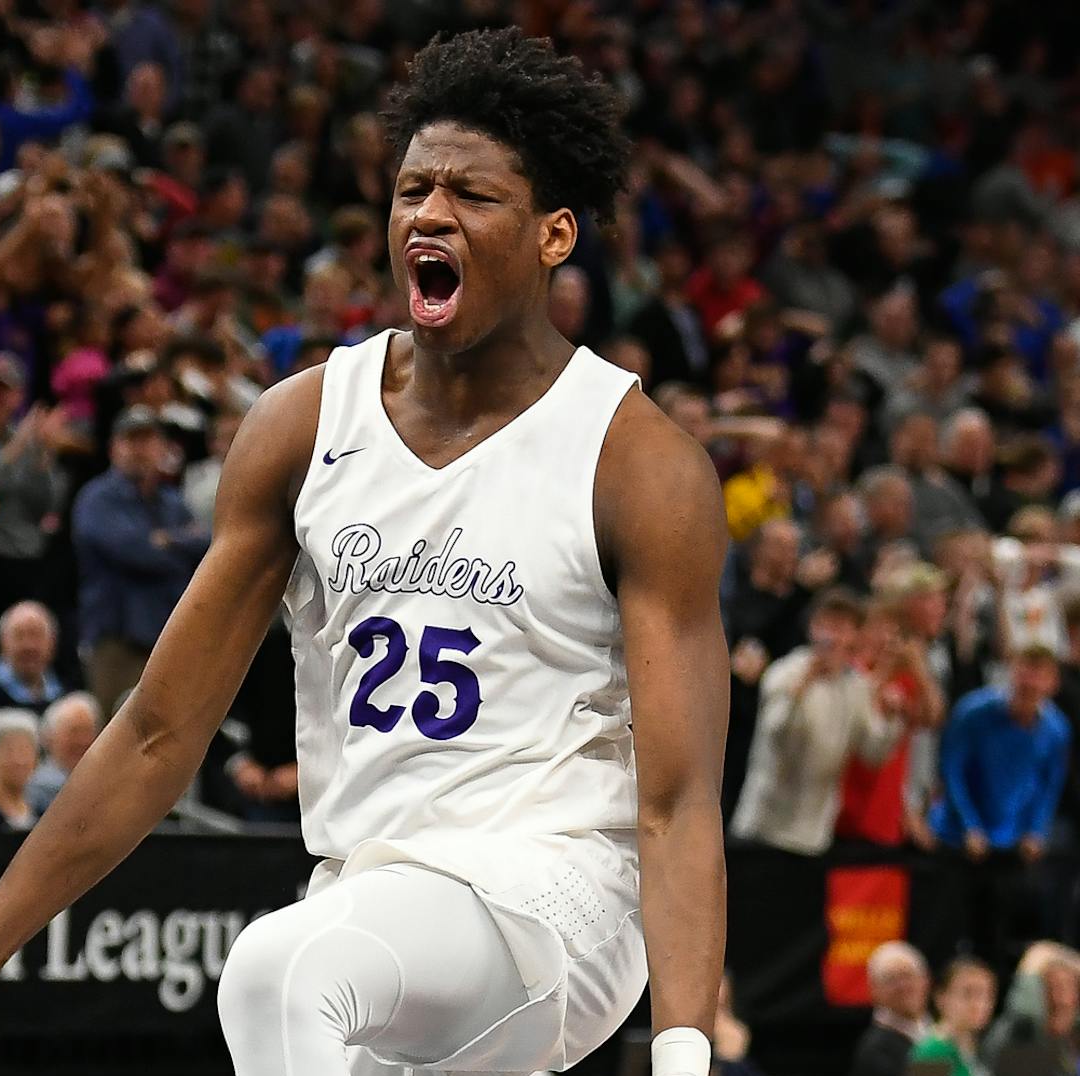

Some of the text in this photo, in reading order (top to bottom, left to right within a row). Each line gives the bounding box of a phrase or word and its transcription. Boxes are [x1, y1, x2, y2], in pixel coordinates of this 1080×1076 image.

[328, 523, 524, 606] Raiders
[348, 615, 484, 741] 25
[38, 906, 272, 1013] Leagu
